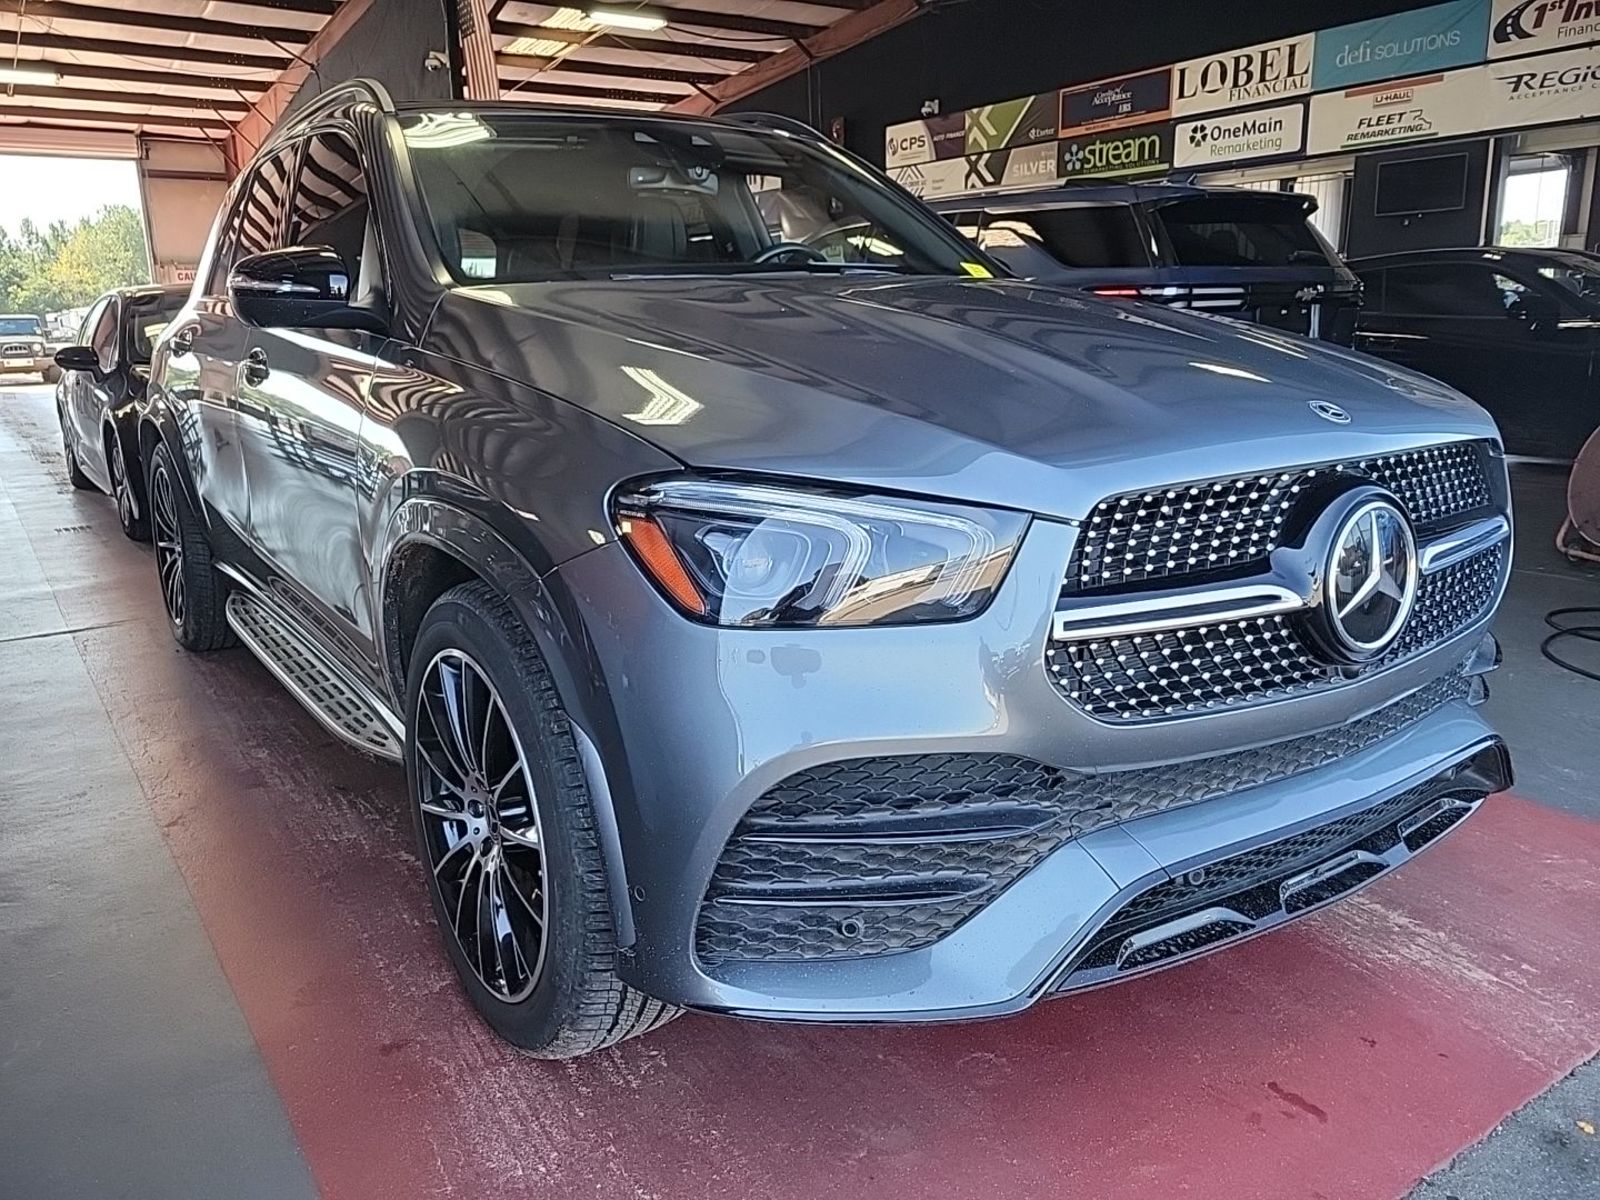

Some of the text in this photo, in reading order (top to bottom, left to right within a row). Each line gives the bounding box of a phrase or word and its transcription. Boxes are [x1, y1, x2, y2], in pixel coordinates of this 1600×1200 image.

[1336, 30, 1461, 67] defi SOLUTIONS
[1177, 42, 1311, 100] LOBEL
[1229, 76, 1309, 102] FINANCIAL
[1508, 86, 1583, 101] ACCEPTANCE
[1210, 117, 1283, 141] OneMain
[1357, 112, 1407, 129] FLEET
[1347, 124, 1424, 141] REMARKETING
[900, 135, 926, 151] CPS
[1083, 135, 1160, 168] stream
[1210, 137, 1282, 157] Remarketing
[1012, 159, 1056, 177] SILVER
